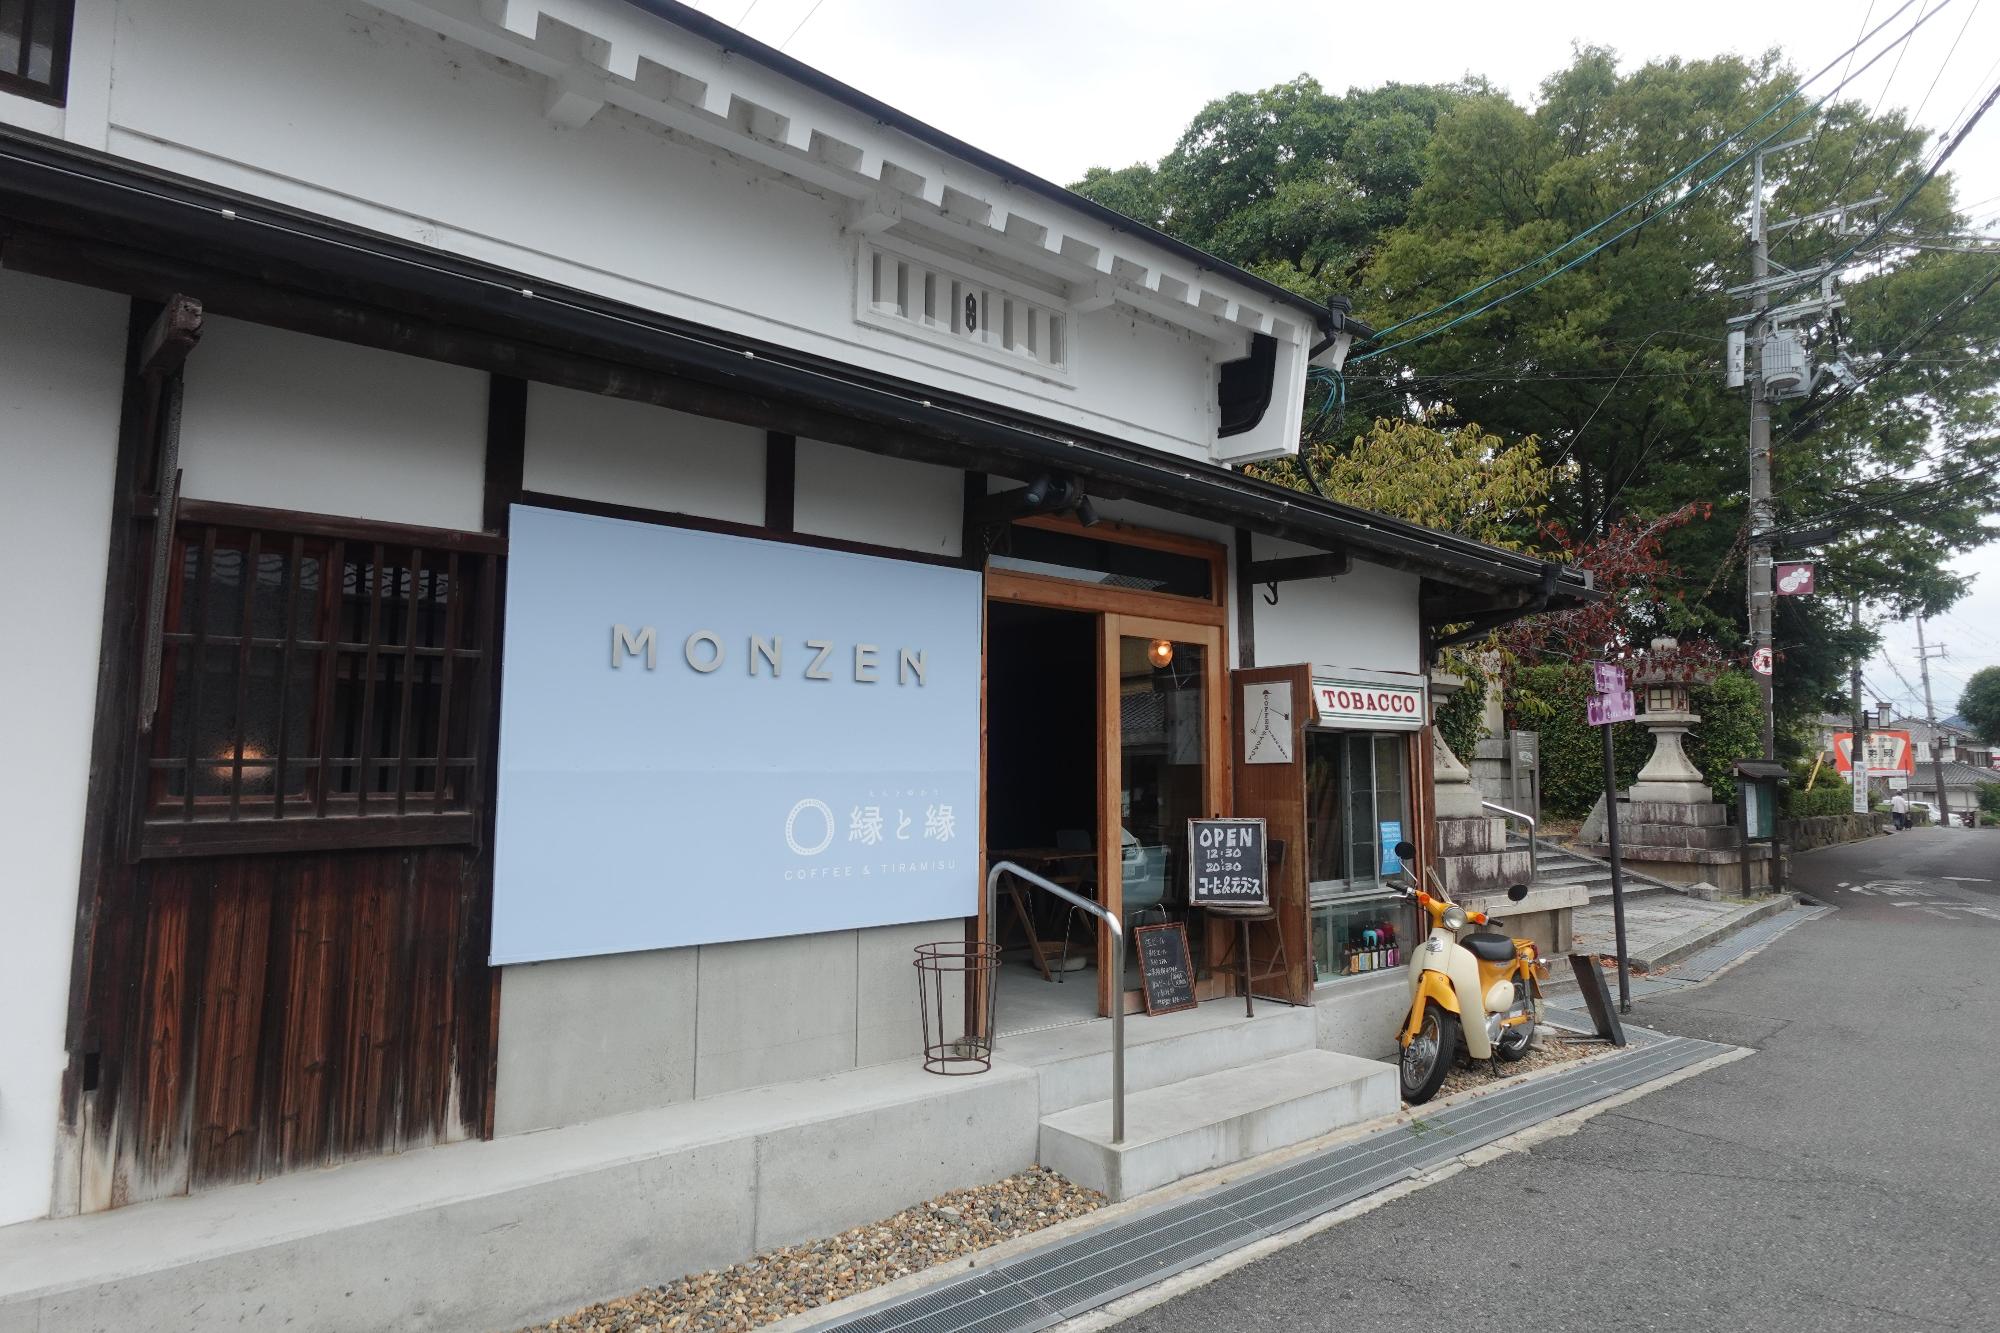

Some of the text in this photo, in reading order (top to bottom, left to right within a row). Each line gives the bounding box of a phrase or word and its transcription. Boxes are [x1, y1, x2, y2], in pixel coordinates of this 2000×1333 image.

[611, 623, 929, 687] MONZEN
[1322, 689, 1416, 714] TOBACCO
[1199, 827, 1252, 848] OPEN
[1206, 848, 1242, 859] 12:30
[784, 859, 956, 881] COFFEE & TIRAMISU
[1205, 861, 1242, 873] 20:30
